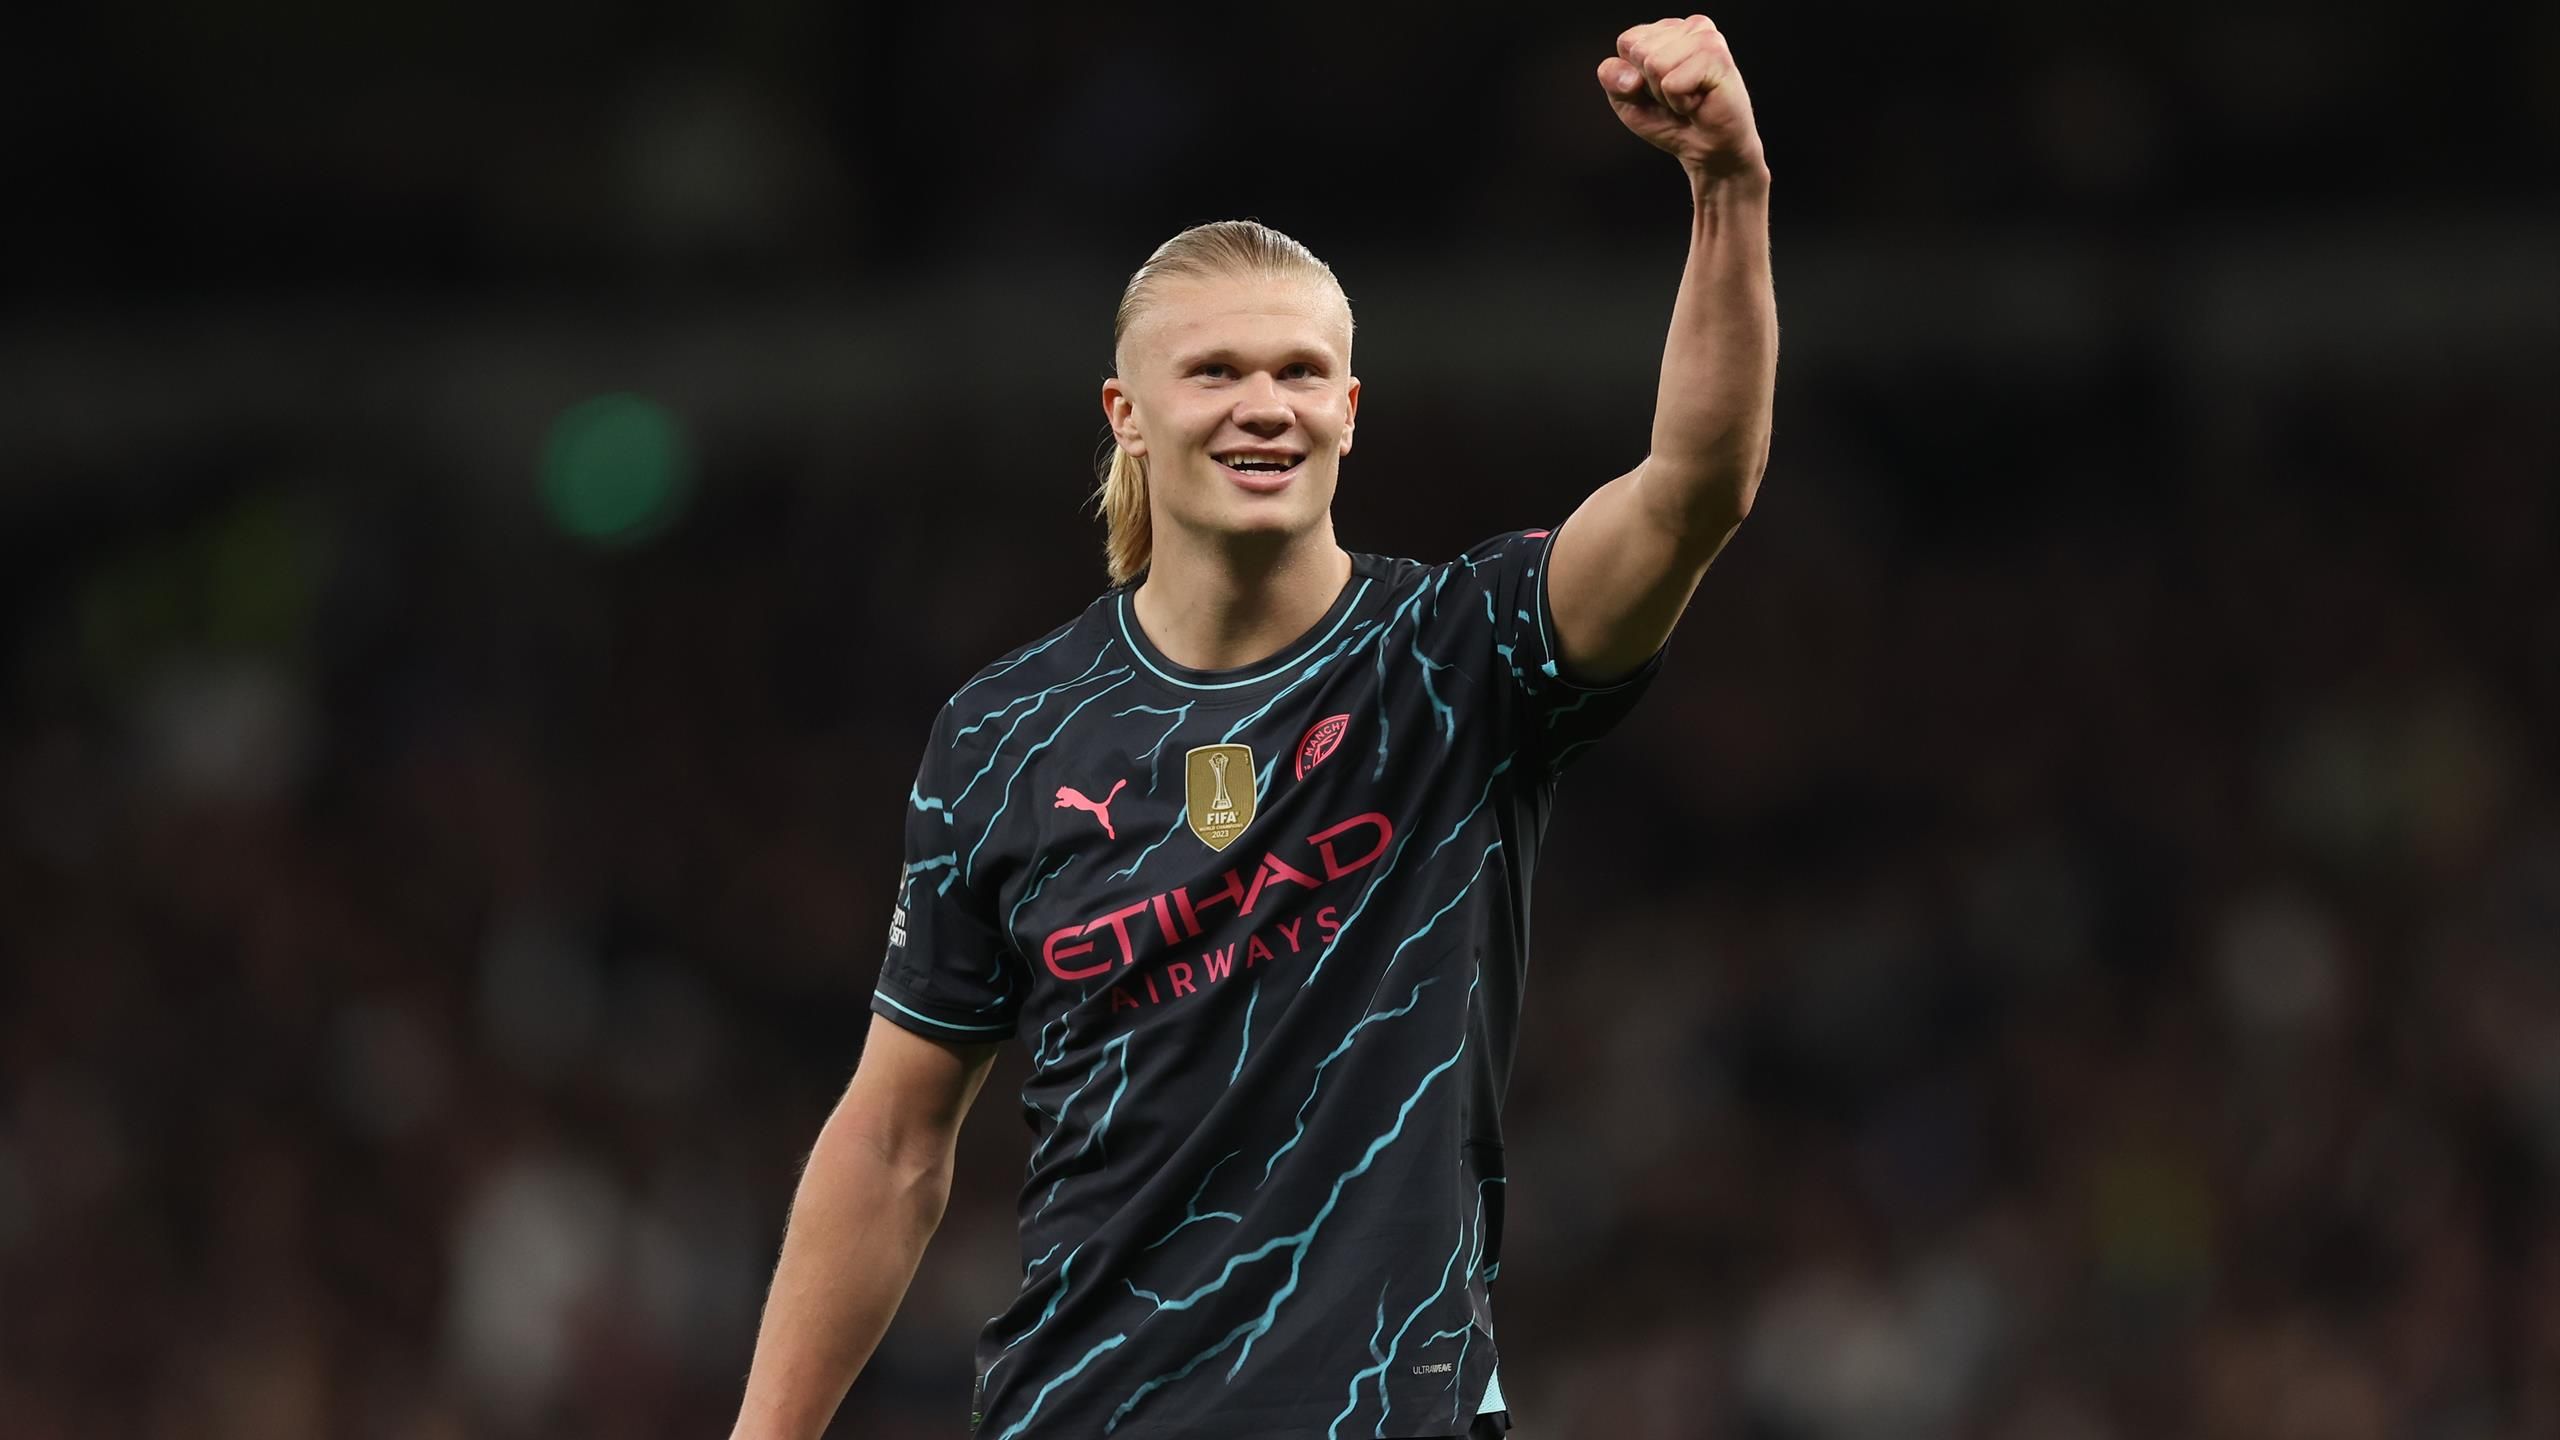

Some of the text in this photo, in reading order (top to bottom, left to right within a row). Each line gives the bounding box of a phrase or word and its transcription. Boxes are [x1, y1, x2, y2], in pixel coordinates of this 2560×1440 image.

[1304, 722, 1345, 757] MANCH
[1206, 811, 1237, 825] FIFA
[1211, 830, 1229, 839] 2023
[1042, 811, 1395, 982] ETIHAD
[1111, 904, 1342, 1014] AIRWAYS
[1412, 1362, 1453, 1375] ULTRAWEAVE
